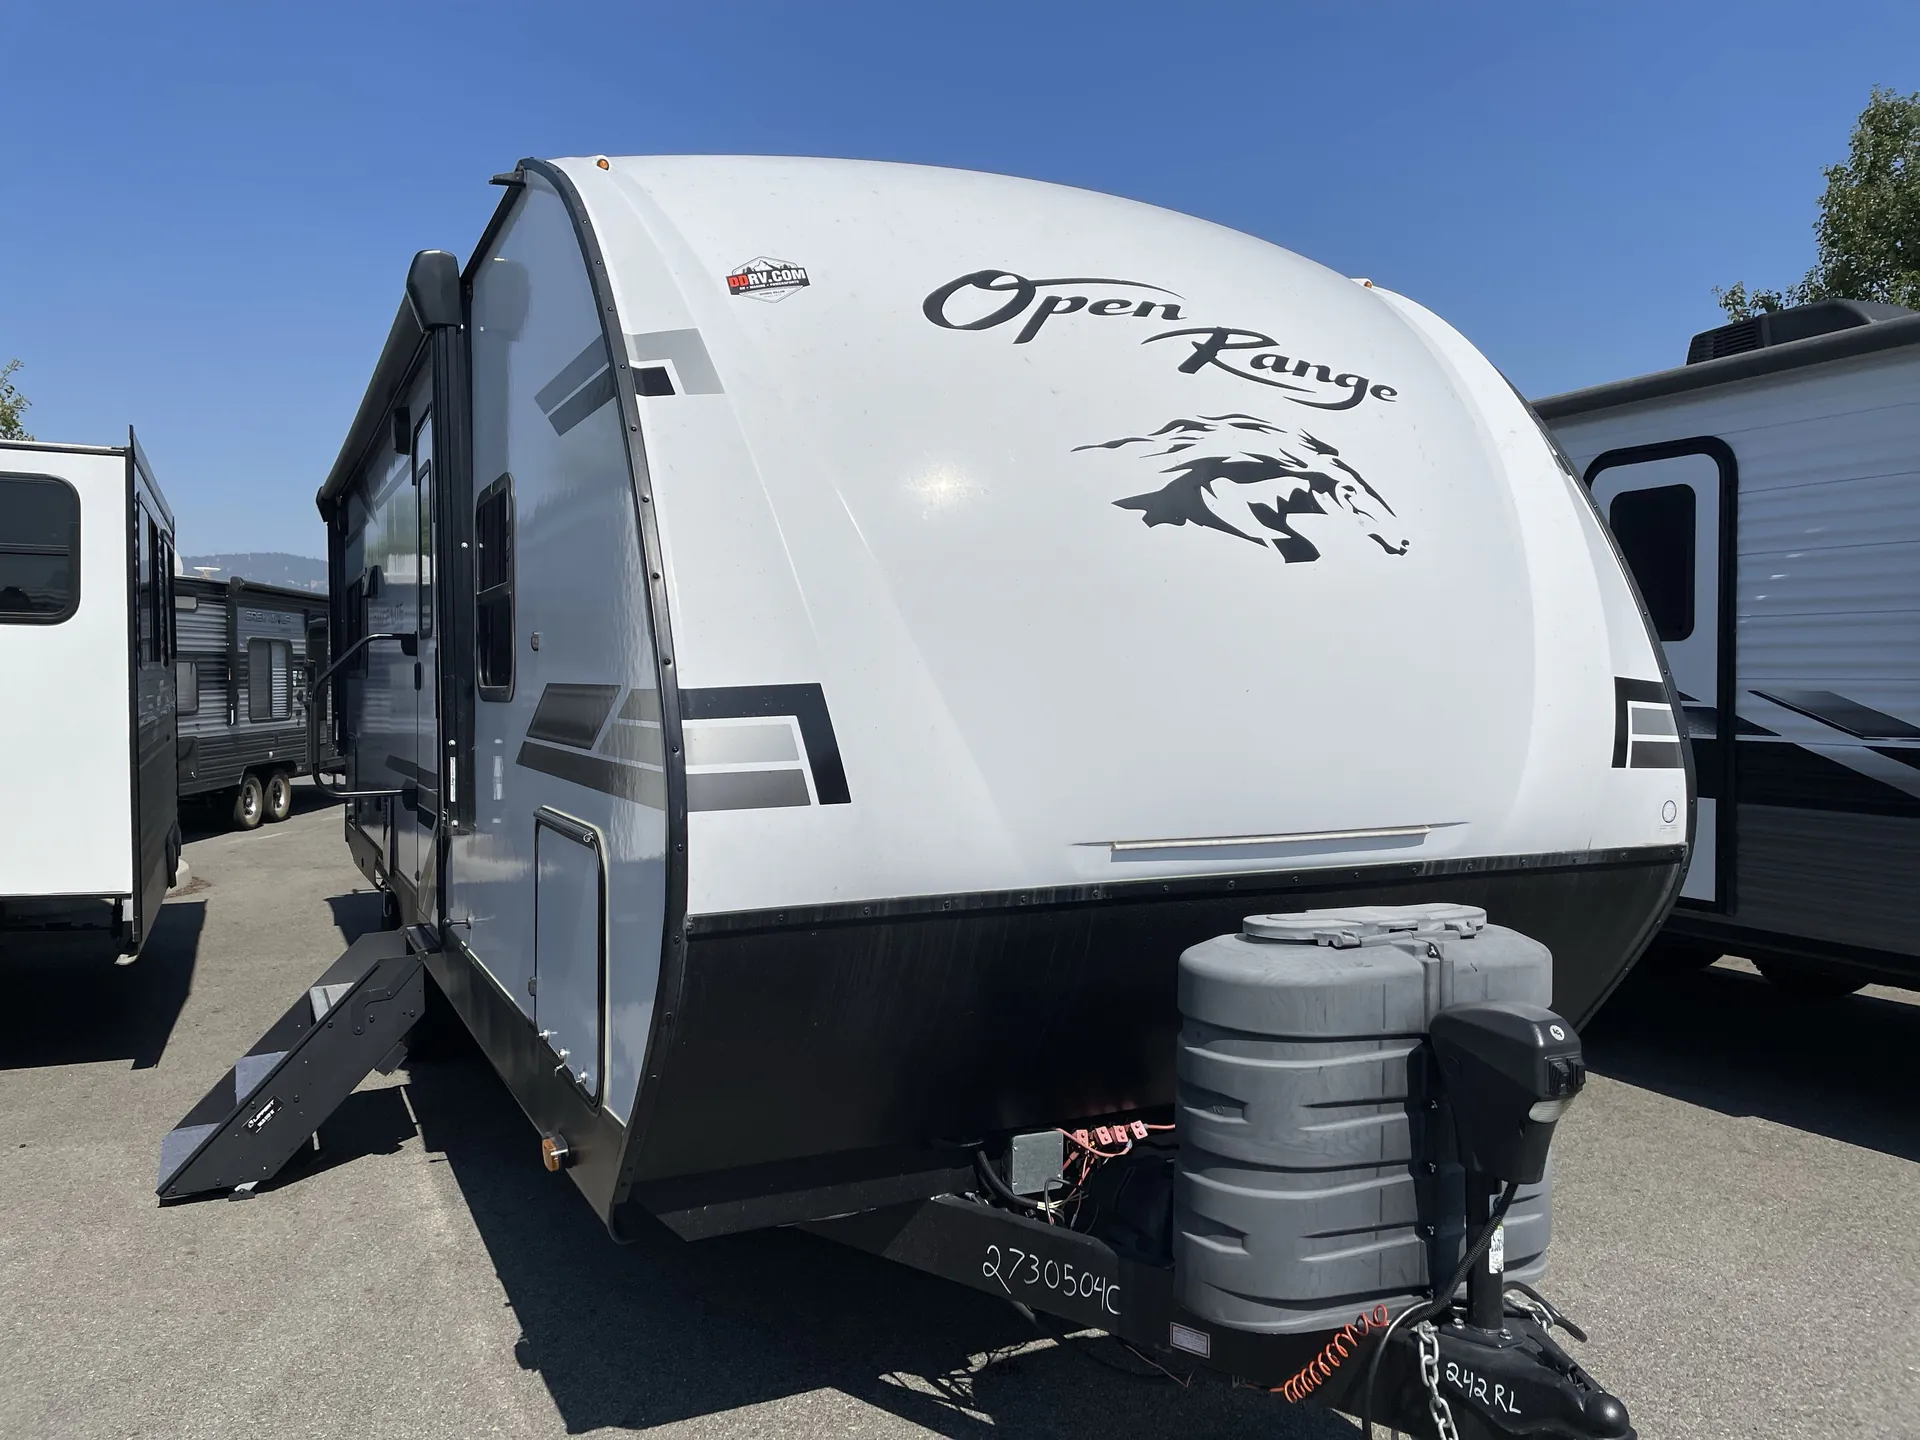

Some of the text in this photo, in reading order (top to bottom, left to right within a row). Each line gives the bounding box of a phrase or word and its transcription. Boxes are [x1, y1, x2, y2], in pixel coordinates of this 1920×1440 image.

[729, 270, 806, 287] DDRV.COM
[922, 270, 1186, 344] Open
[1141, 326, 1398, 412] Range
[982, 1244, 1122, 1315] 2730504C
